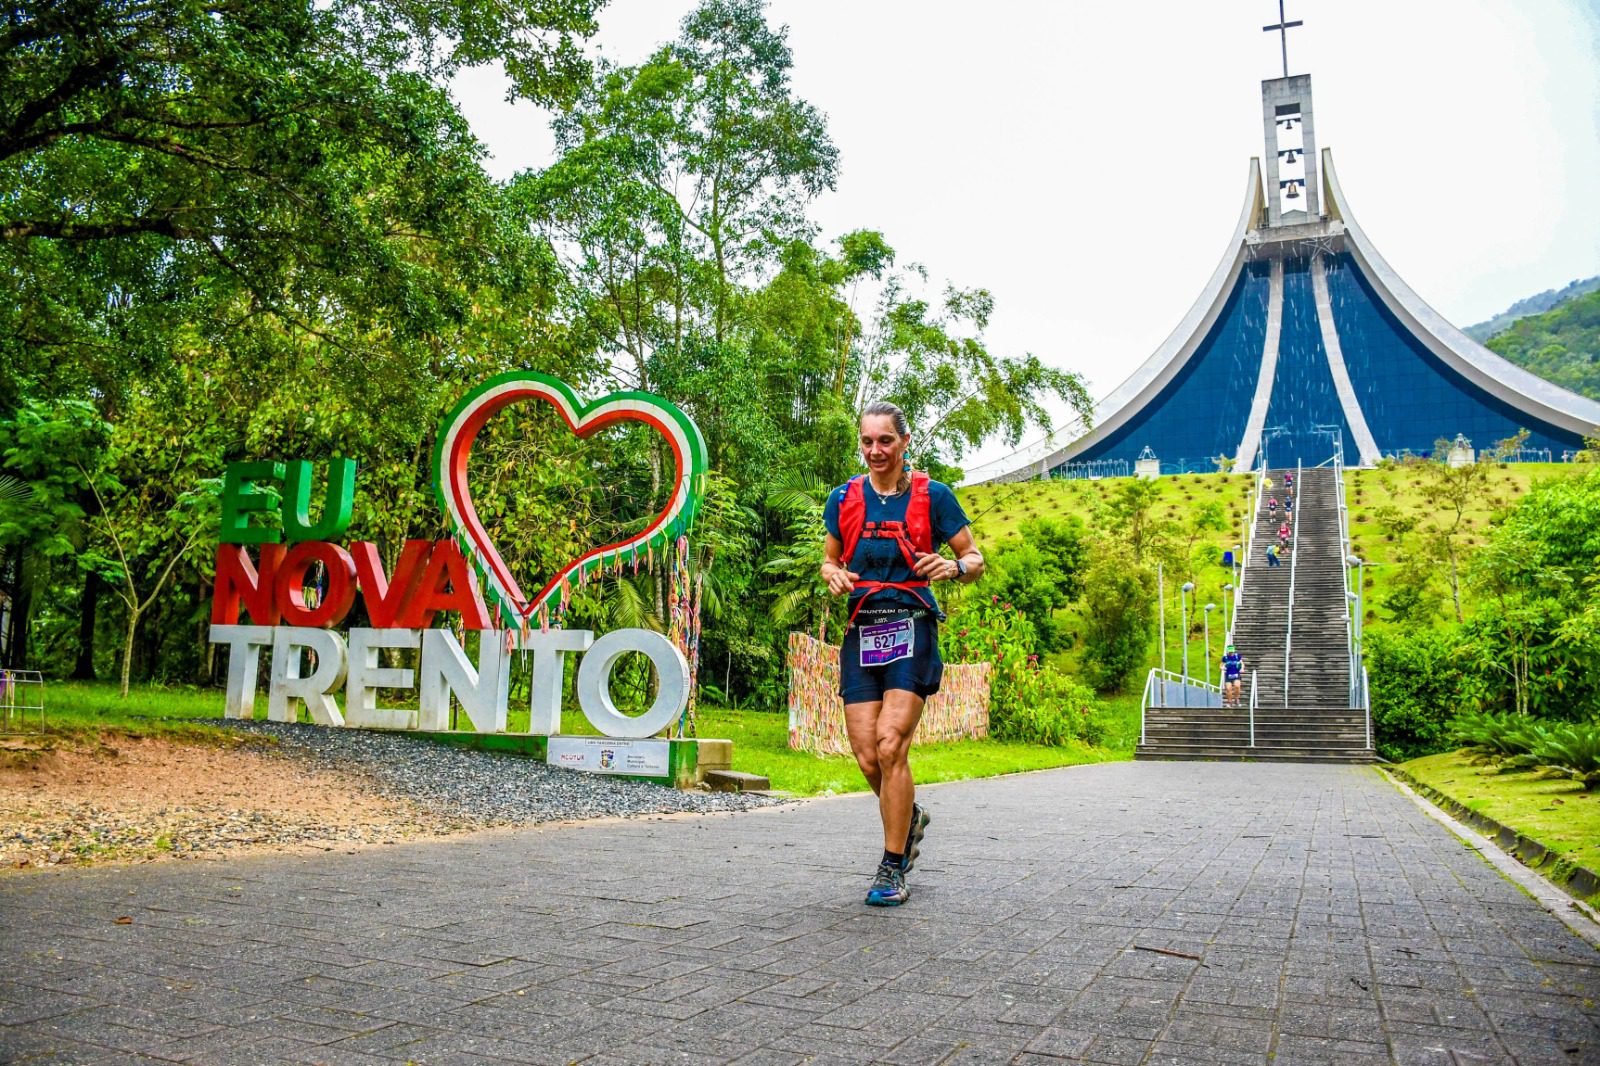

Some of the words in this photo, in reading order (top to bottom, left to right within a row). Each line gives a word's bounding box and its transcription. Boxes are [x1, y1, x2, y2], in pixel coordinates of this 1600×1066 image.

[220, 457, 356, 544] EU
[210, 538, 493, 630] NOVA
[208, 624, 691, 739] TRENTO
[874, 633, 897, 649] 627
